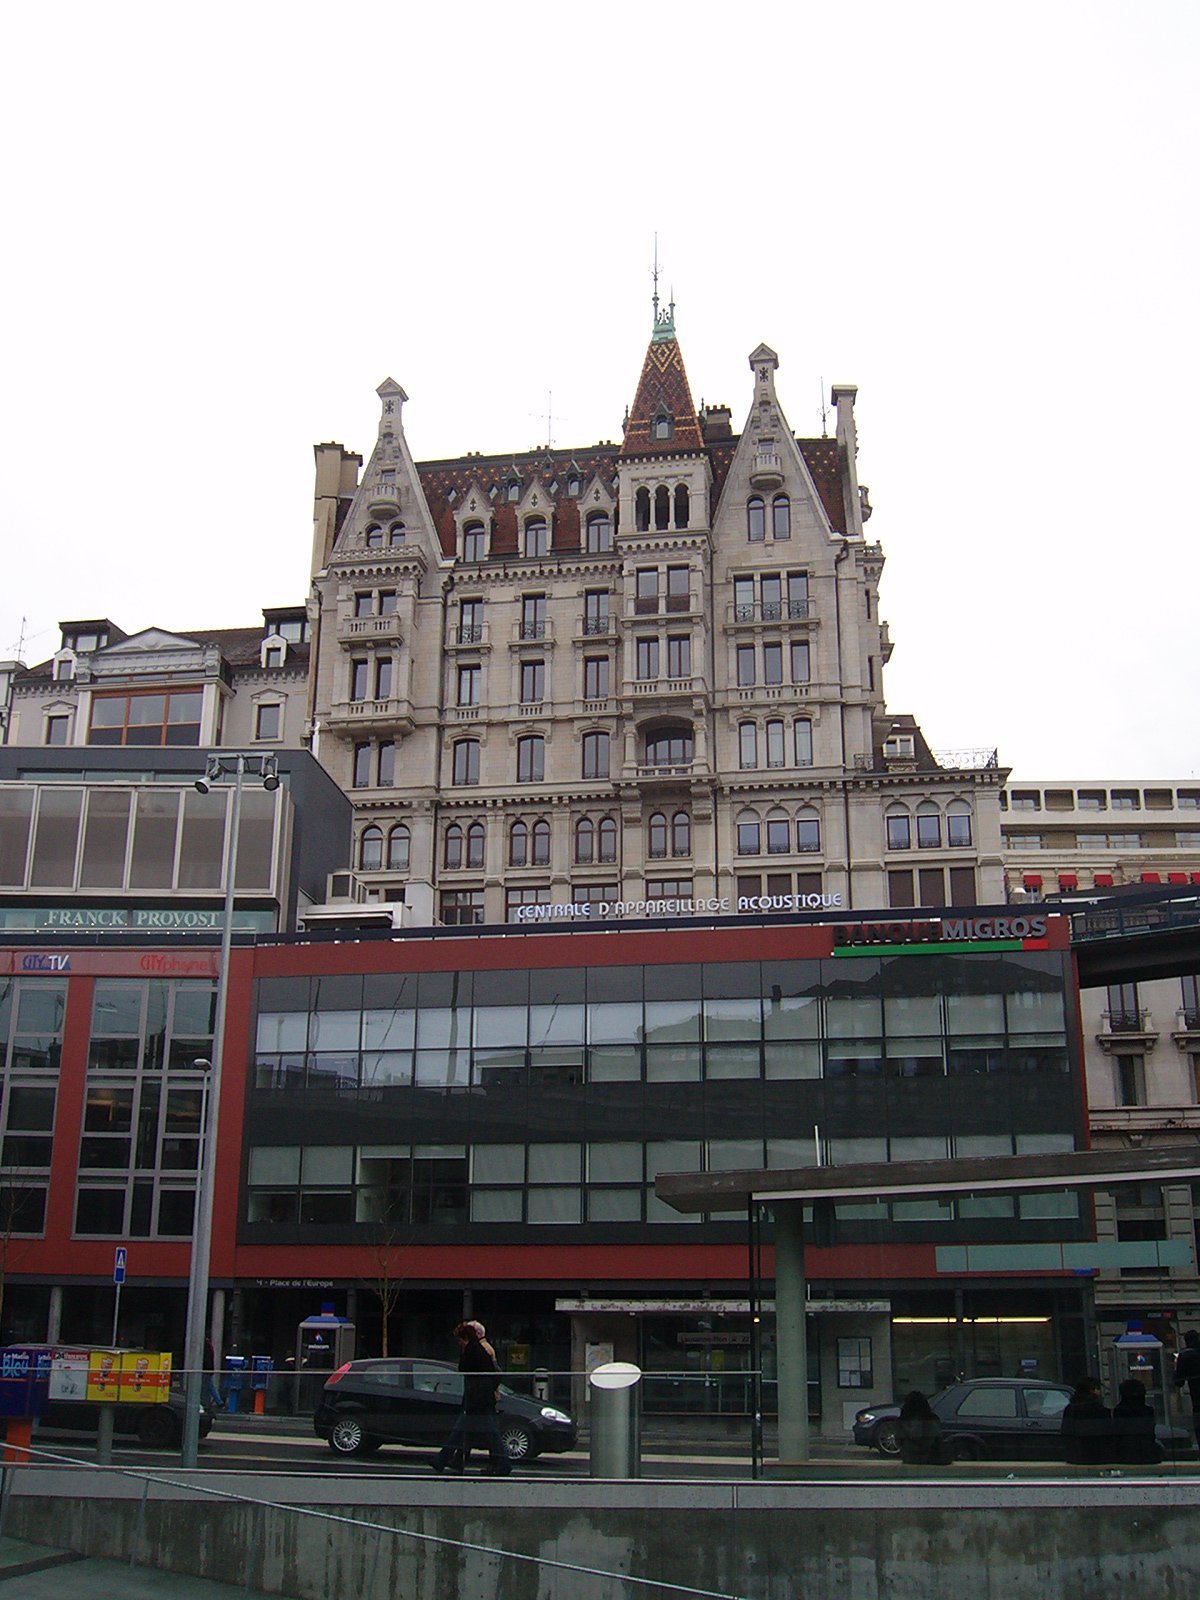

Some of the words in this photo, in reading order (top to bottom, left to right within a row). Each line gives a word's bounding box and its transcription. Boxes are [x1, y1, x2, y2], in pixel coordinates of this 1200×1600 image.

[517, 902, 591, 919] CENTRALE
[598, 897, 730, 916] D'APPAREILLAGE
[738, 892, 843, 911] ACOUSTIQUE
[47, 909, 126, 926] FRANCK
[137, 911, 220, 927] PROVOST
[942, 915, 1048, 940] MIGROS
[47, 954, 70, 971] TV
[269, 1279, 290, 1287] Place
[292, 1279, 302, 1287] de
[303, 1279, 334, 1289] l'Europe
